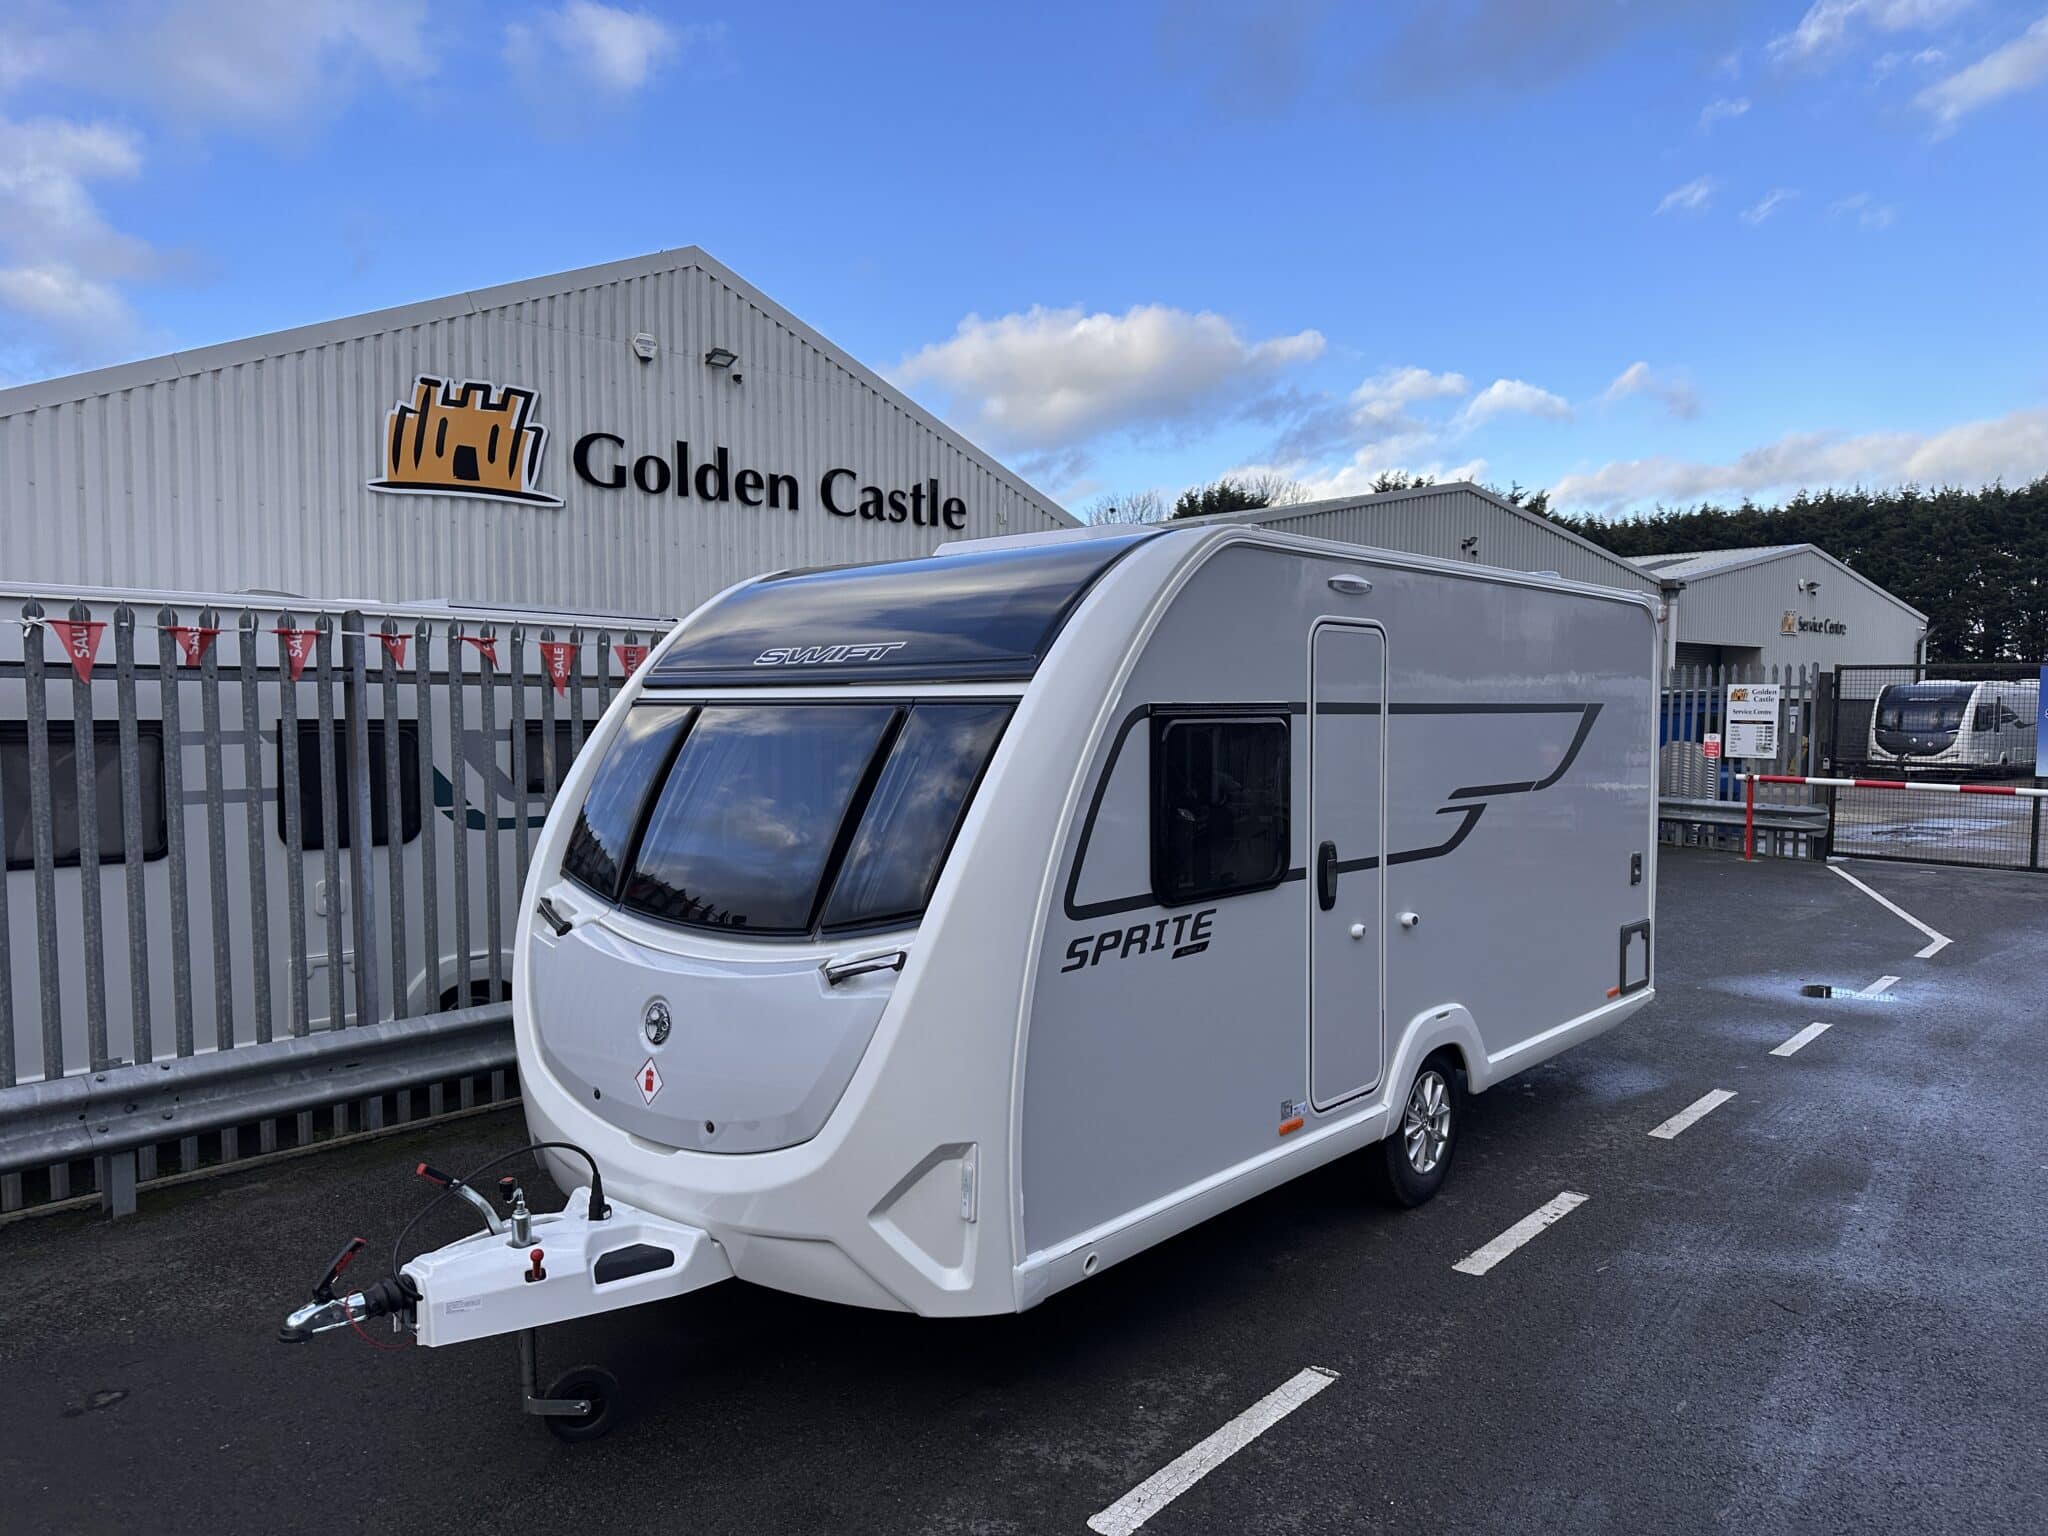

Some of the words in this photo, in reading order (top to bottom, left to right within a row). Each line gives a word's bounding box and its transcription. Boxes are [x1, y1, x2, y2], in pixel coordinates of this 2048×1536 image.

[573, 432, 800, 511] Golden
[820, 467, 967, 530] Castle
[1799, 616, 1823, 633] Service
[553, 647, 565, 678] SALE
[753, 641, 908, 666] SWIFT
[1751, 688, 1777, 696] Golden
[1753, 695, 1775, 703] Castle
[1060, 908, 1217, 974] SPRITE
